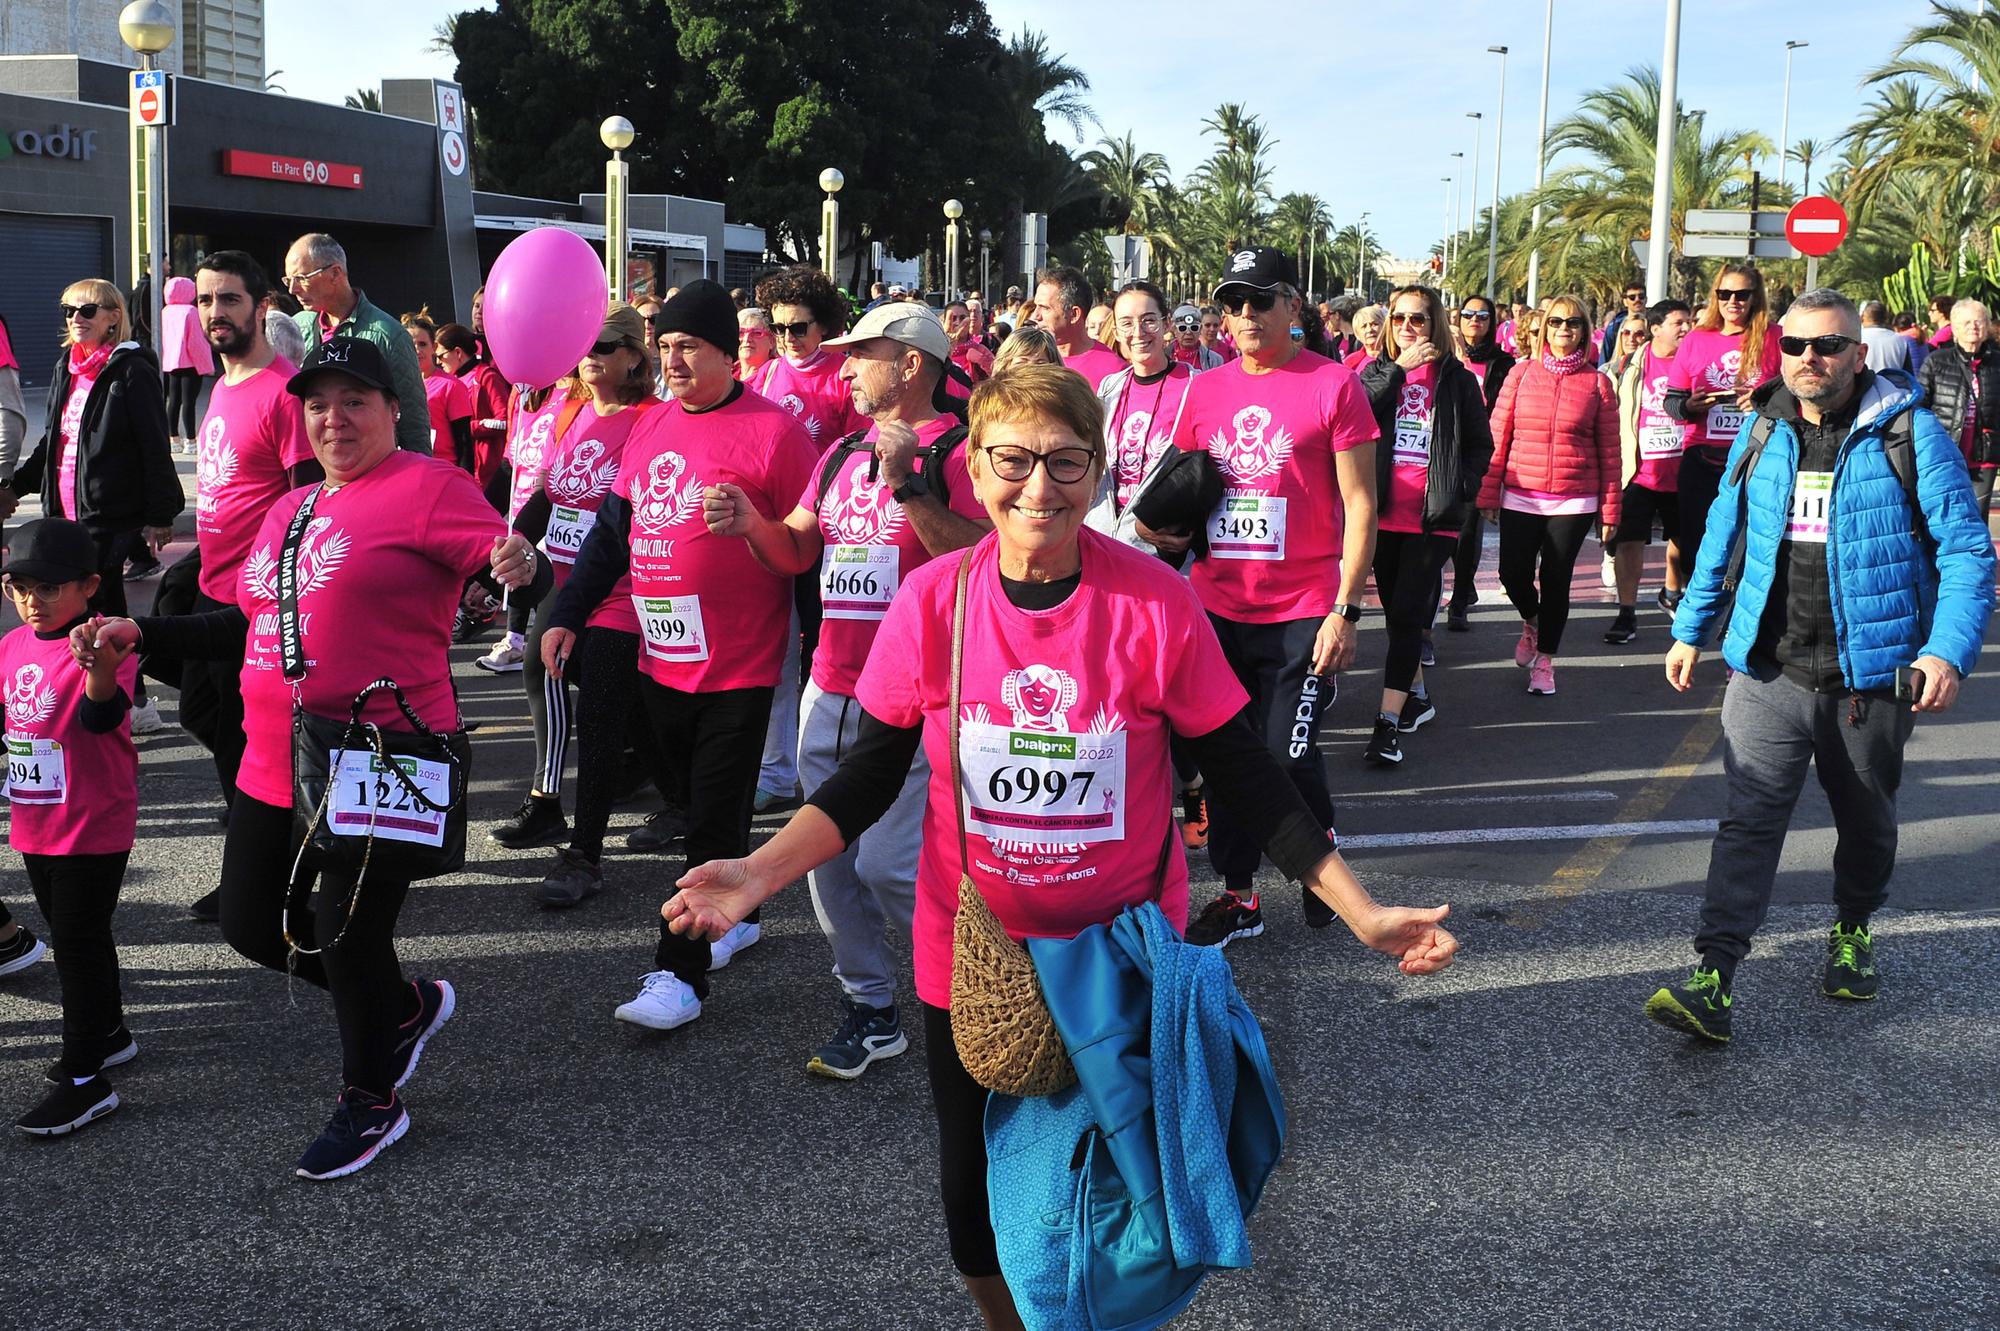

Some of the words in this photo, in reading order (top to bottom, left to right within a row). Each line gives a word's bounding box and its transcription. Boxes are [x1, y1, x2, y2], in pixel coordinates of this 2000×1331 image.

[16, 123, 98, 161] adif
[271, 162, 282, 174] Elx
[284, 163, 300, 177] Parc
[1648, 436, 1678, 449] 5389
[548, 523, 584, 548] 4665
[1216, 517, 1268, 539] 3493
[868, 555, 890, 564] 2022
[282, 547, 295, 601] BIMBA
[825, 569, 878, 596] 4666
[672, 605, 692, 613] 2022
[282, 610, 297, 670] BIMBA
[646, 618, 686, 641] 4399
[33, 748, 53, 757] 2022
[1013, 737, 1073, 754] Dialprix
[1078, 747, 1115, 760] 2022
[418, 769, 442, 782] 2022
[988, 765, 1096, 807] 6997
[1004, 816, 1033, 825] CONTRA
[1073, 818, 1083, 826] DE
[1084, 816, 1106, 826] MAMA
[975, 859, 1004, 876] Dialprix
[1066, 866, 1097, 881] INDITEX
[1003, 854, 1029, 865] ribera
